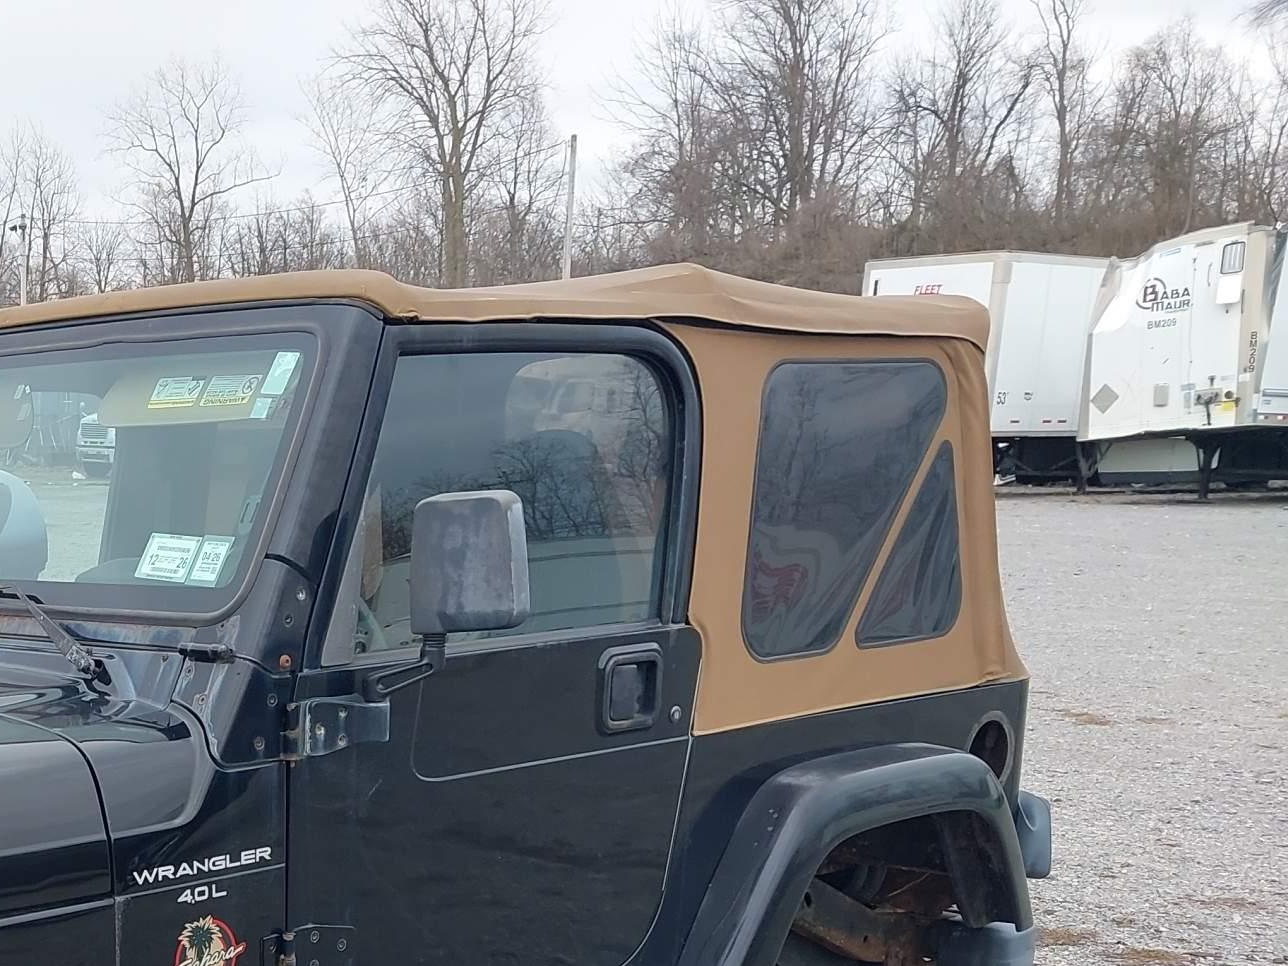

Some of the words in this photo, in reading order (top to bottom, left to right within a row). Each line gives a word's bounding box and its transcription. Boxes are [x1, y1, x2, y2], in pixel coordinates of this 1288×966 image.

[914, 284, 943, 296] FLEET
[1143, 284, 1190, 303] BABA
[1147, 318, 1177, 330] BM209
[1249, 331, 1258, 373] BM209
[176, 557, 189, 569] 26
[133, 846, 272, 886] WRANGLER
